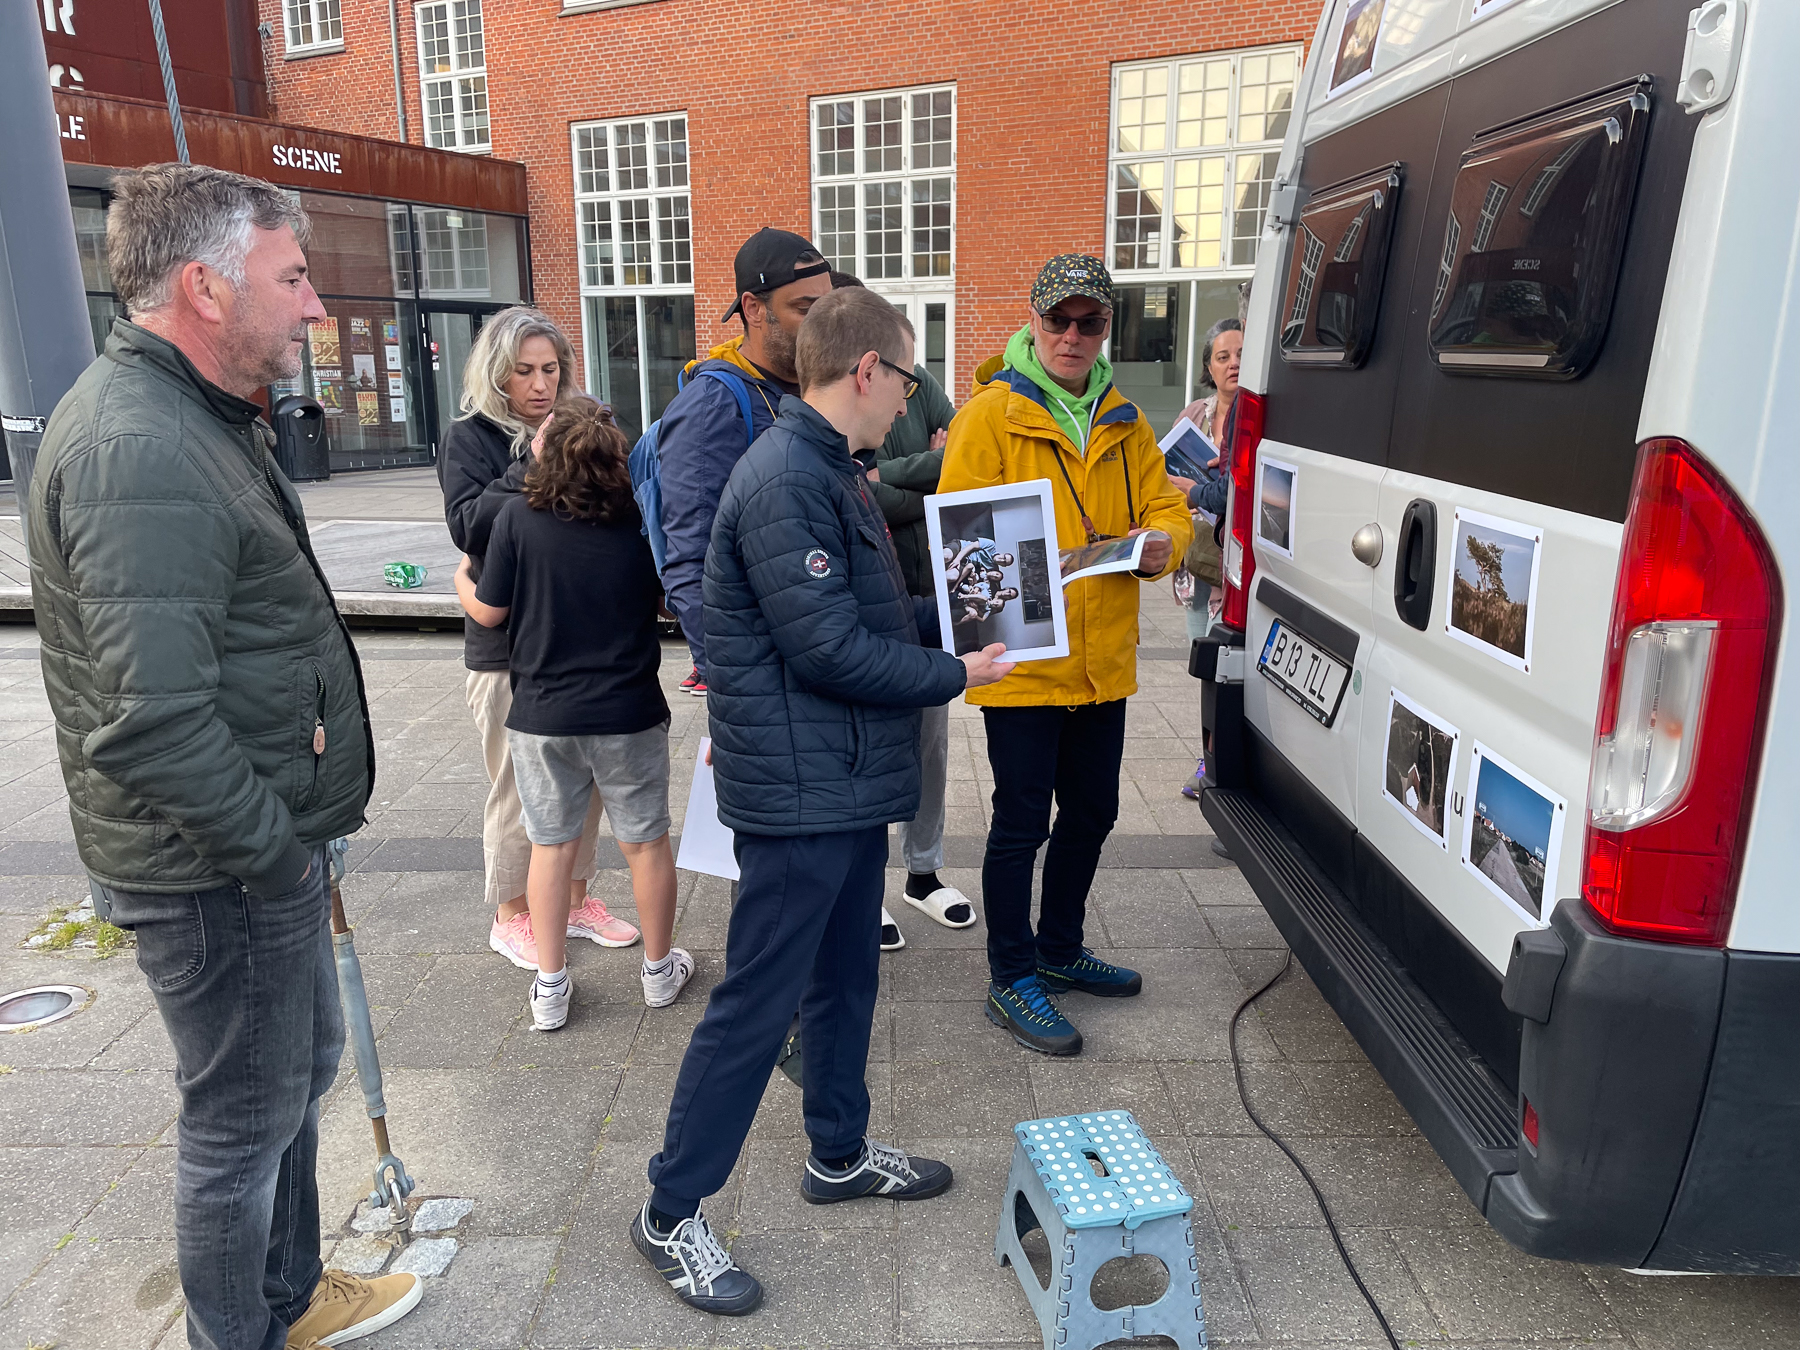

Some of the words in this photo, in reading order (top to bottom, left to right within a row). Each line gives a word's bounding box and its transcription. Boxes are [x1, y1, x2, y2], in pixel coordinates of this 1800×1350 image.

[272, 144, 342, 174] SCENE
[1065, 269, 1088, 278] VANS
[312, 369, 342, 378] CHRISTIAN
[1271, 631, 1287, 667] B
[1284, 641, 1303, 678] 13
[1303, 652, 1331, 704] TLL
